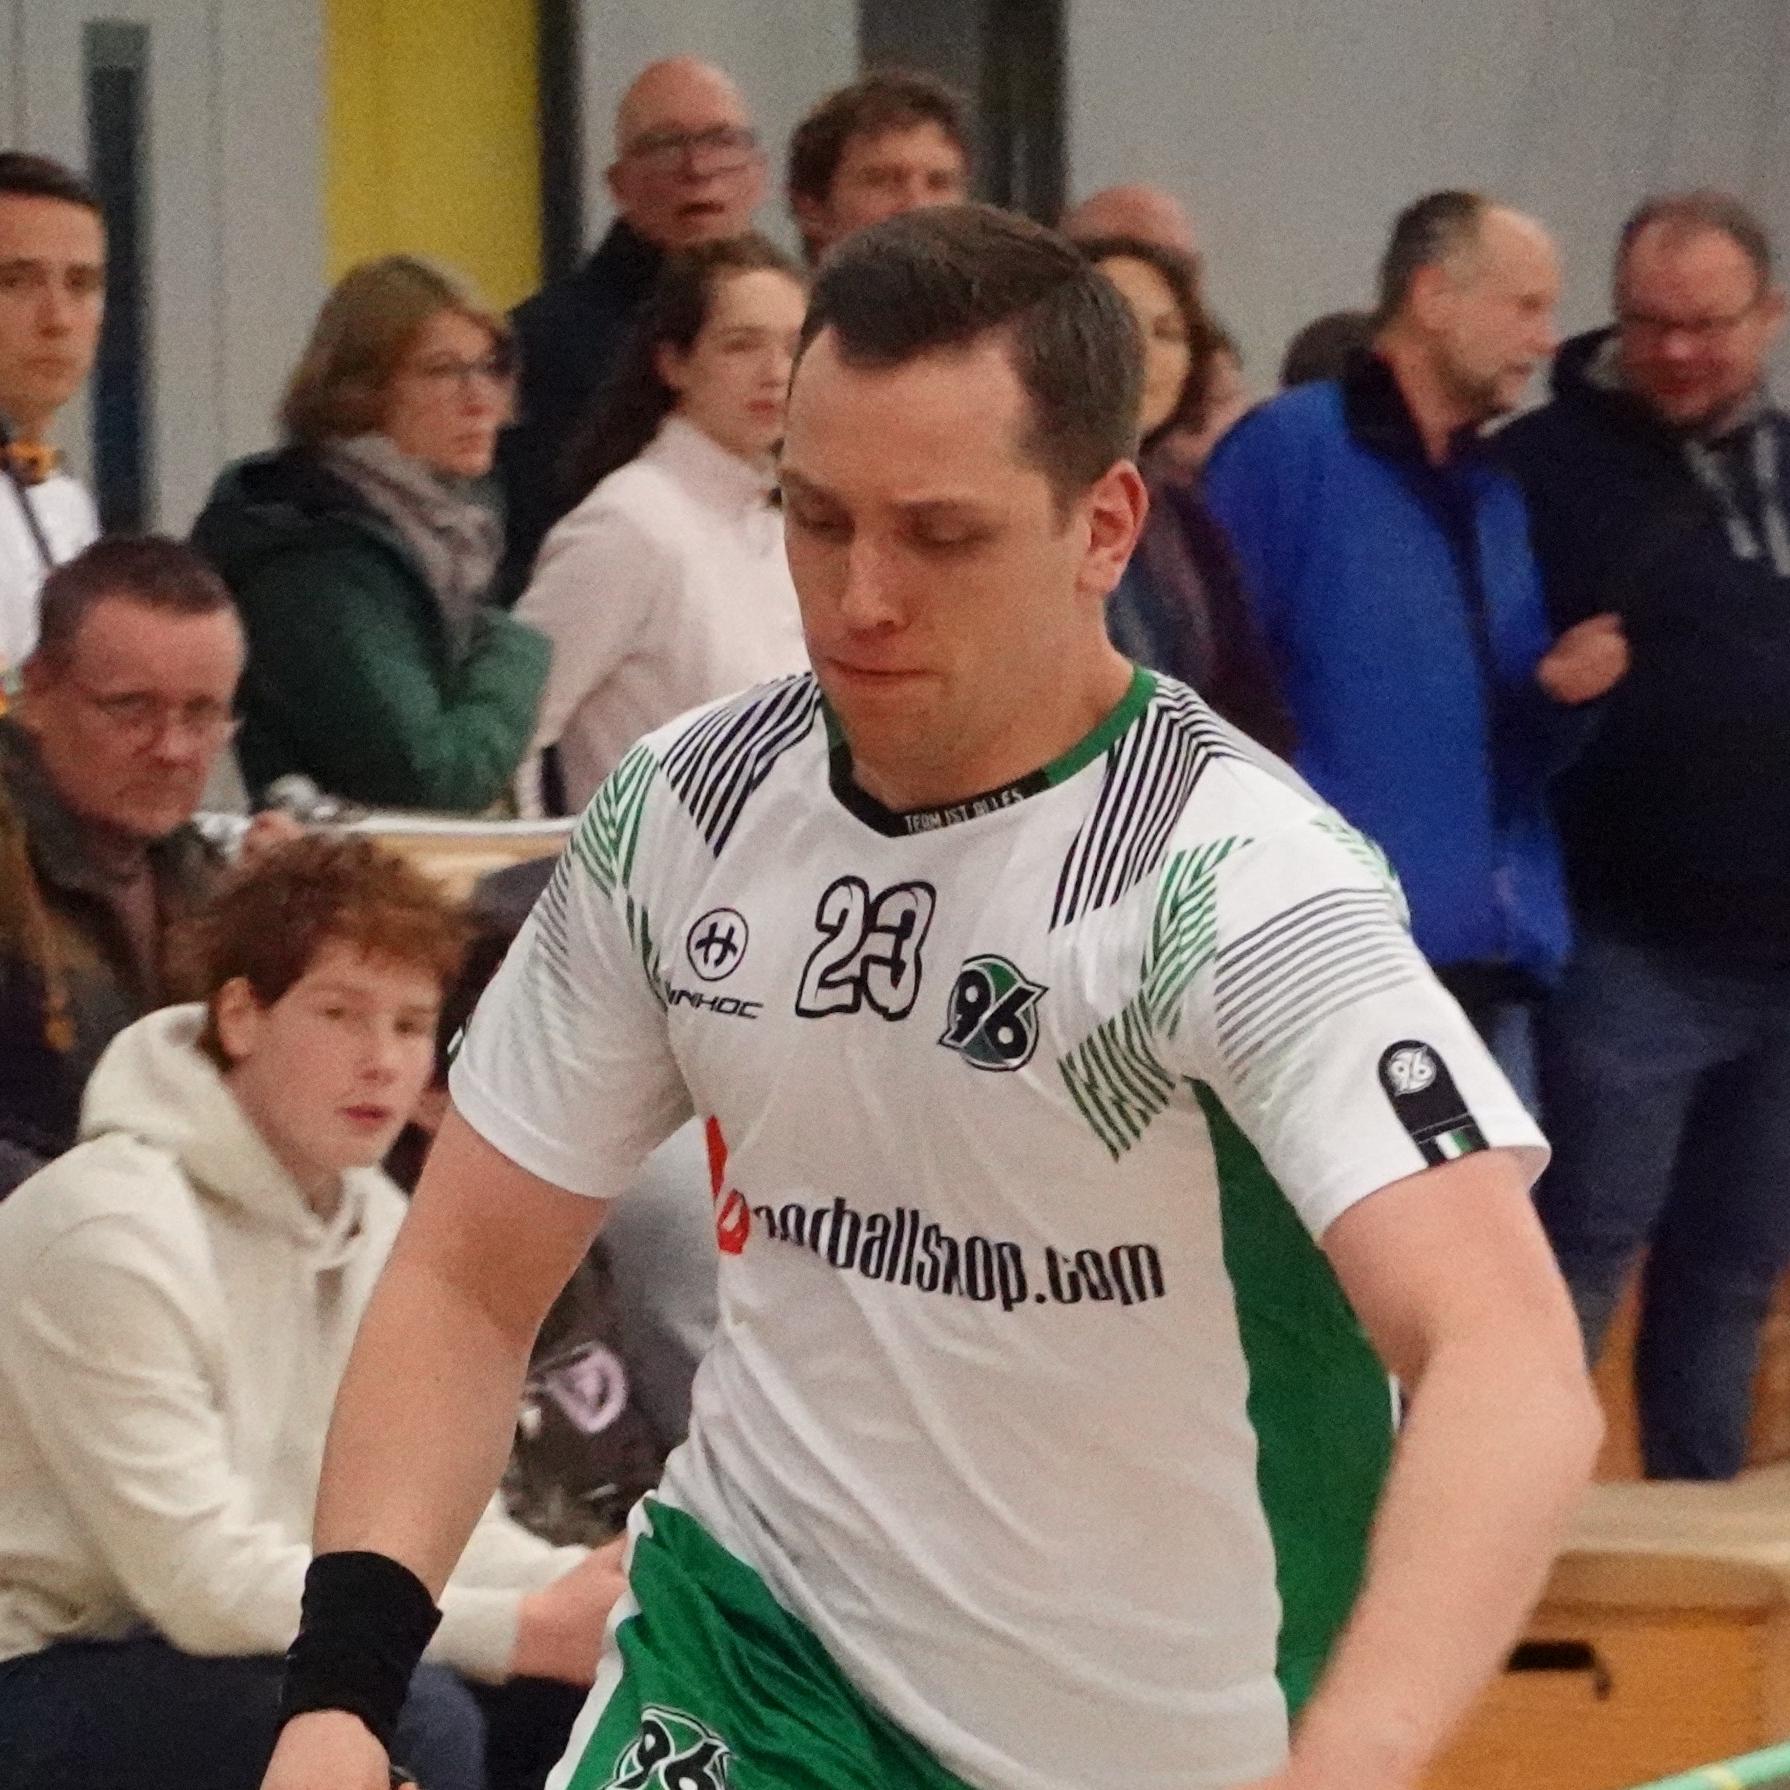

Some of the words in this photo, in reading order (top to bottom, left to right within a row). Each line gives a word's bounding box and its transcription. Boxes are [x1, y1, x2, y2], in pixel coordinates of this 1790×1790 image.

[794, 874, 938, 1022] 23
[944, 965, 1043, 1064] 96
[1390, 1049, 1433, 1093] 96
